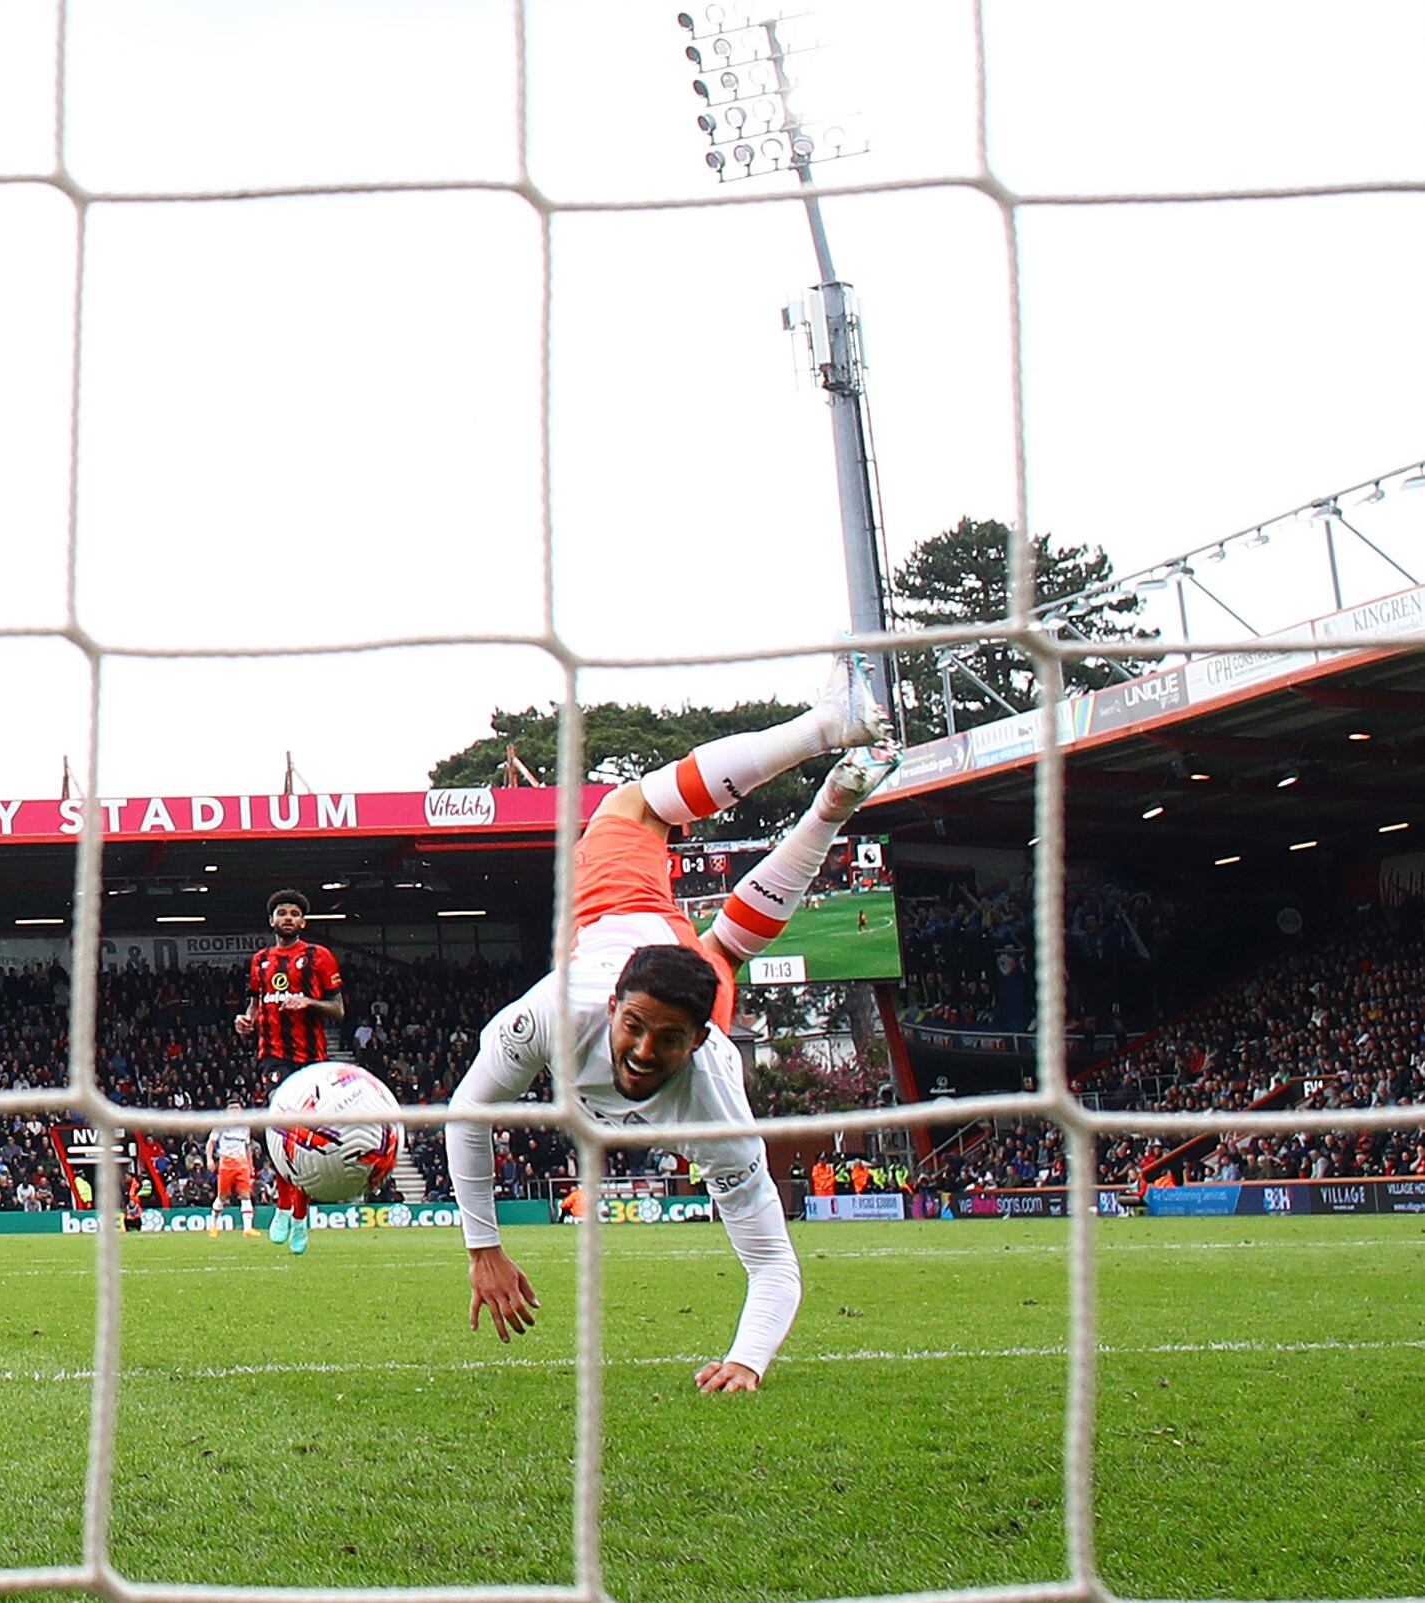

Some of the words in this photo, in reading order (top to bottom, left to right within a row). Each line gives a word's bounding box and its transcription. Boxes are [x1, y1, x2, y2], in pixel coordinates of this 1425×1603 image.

[1124, 673, 1179, 706] UNIQUE
[59, 794, 358, 835] STADIUM
[428, 790, 491, 825] Vitality
[187, 936, 268, 951] ROOFING
[762, 962, 792, 977] 71:13
[1320, 1185, 1366, 1204] VILLAGE
